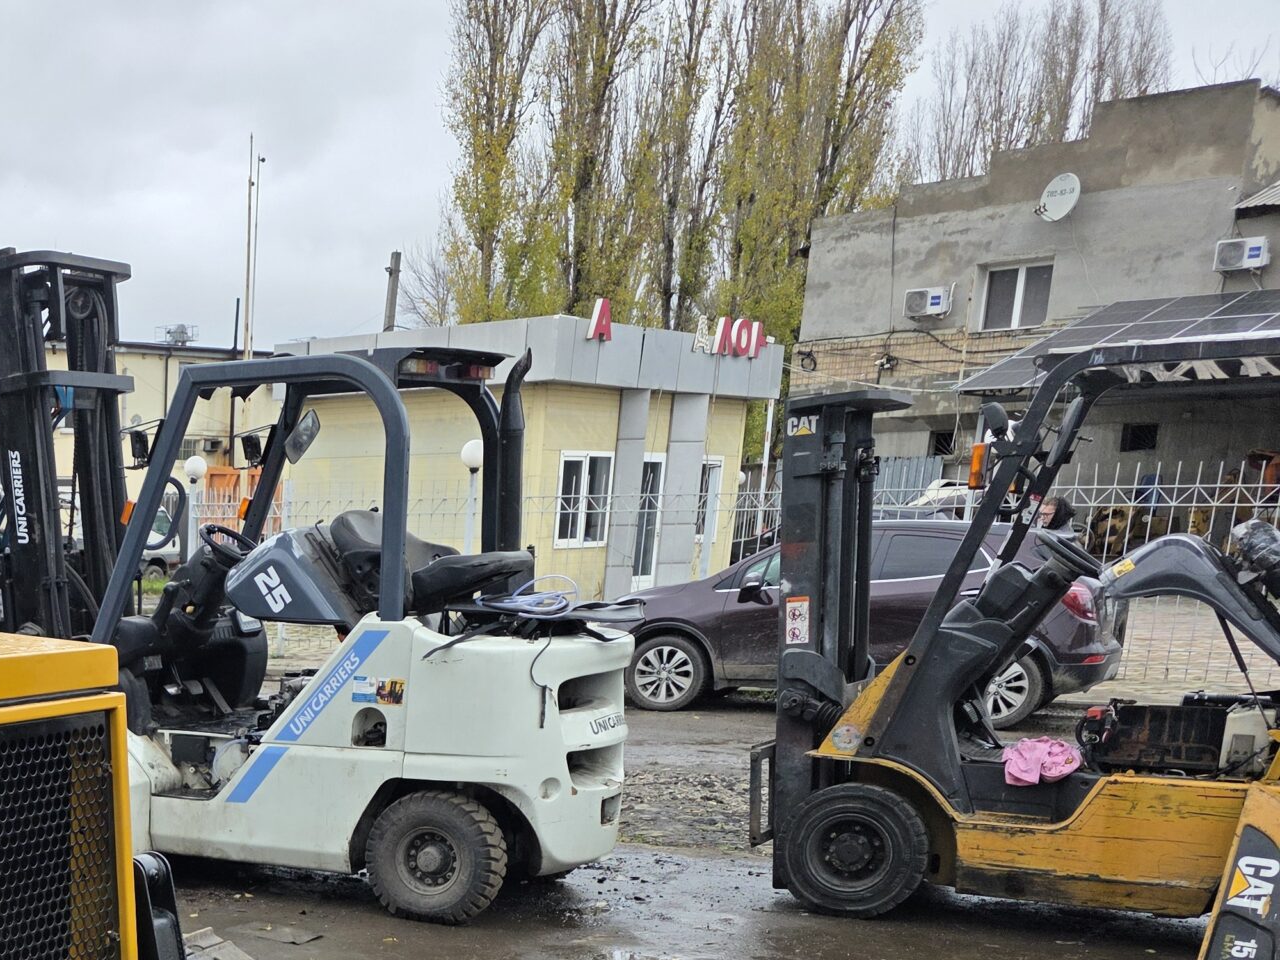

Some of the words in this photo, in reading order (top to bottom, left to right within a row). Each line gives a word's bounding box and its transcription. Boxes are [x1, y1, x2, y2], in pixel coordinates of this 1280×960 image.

[787, 415, 820, 437] CAT
[253, 565, 293, 614] 25
[1226, 855, 1280, 918] CAT
[1231, 939, 1258, 959] 15
